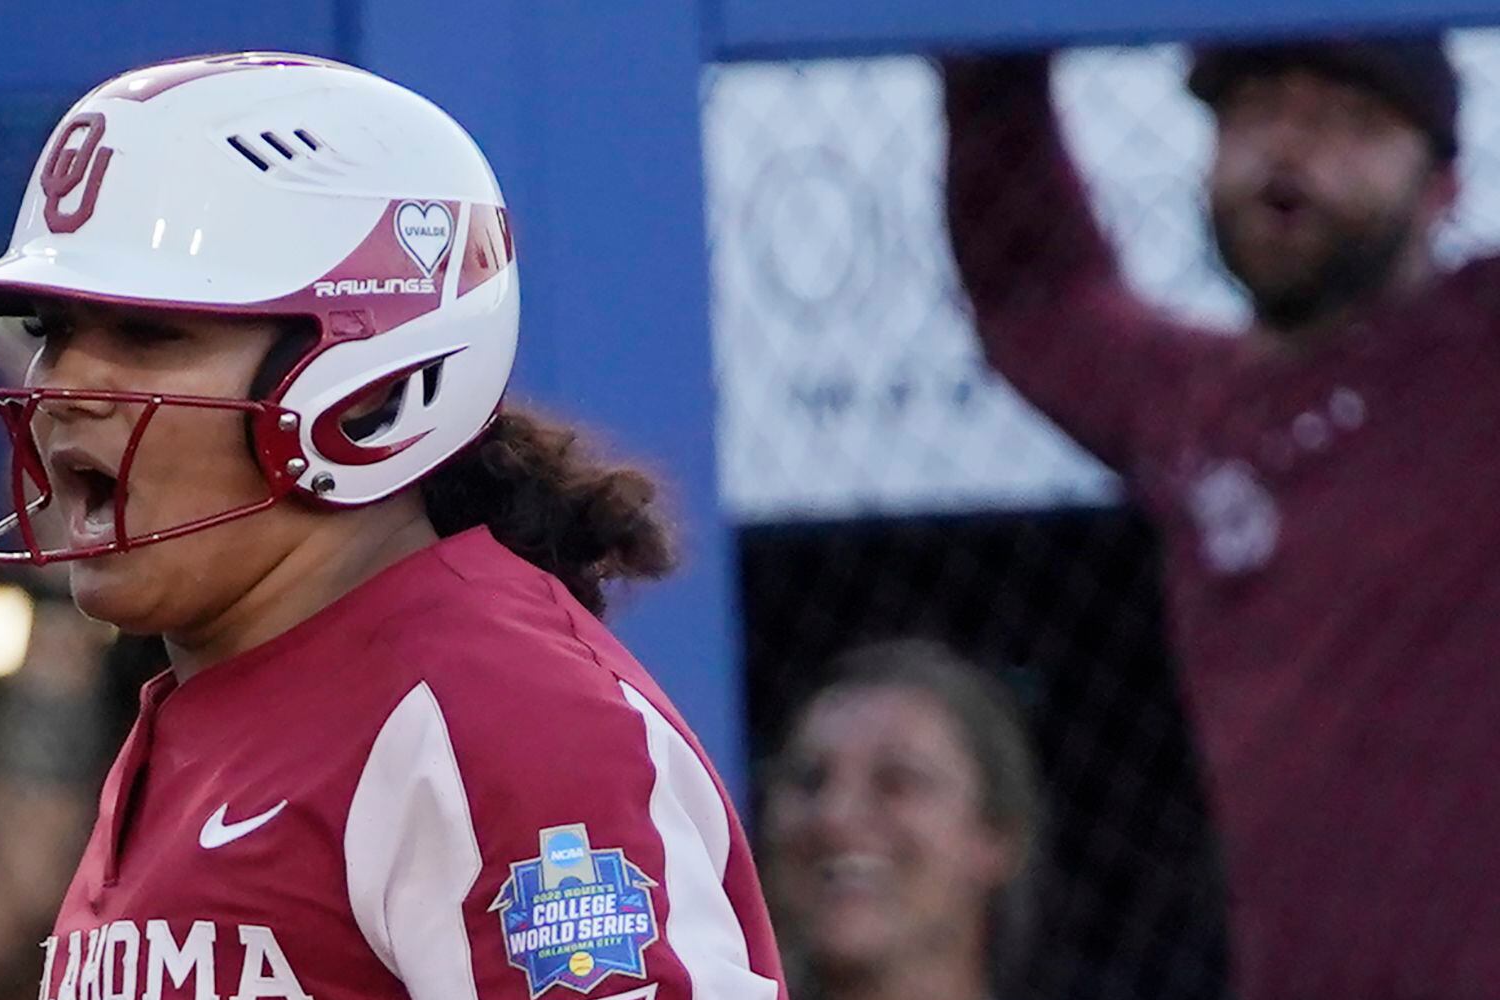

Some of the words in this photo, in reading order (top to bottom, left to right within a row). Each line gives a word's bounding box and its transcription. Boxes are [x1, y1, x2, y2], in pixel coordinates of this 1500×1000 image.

[40, 112, 114, 234] OU
[404, 226, 447, 238] UVALDE
[313, 278, 436, 298] RAWLINGS
[551, 847, 584, 861] NCAA
[533, 893, 617, 926] COLLEGE
[510, 921, 575, 954] WORLD
[578, 913, 648, 940] SERIES
[538, 941, 594, 958] OKLAHOMA
[596, 937, 623, 948] CITY
